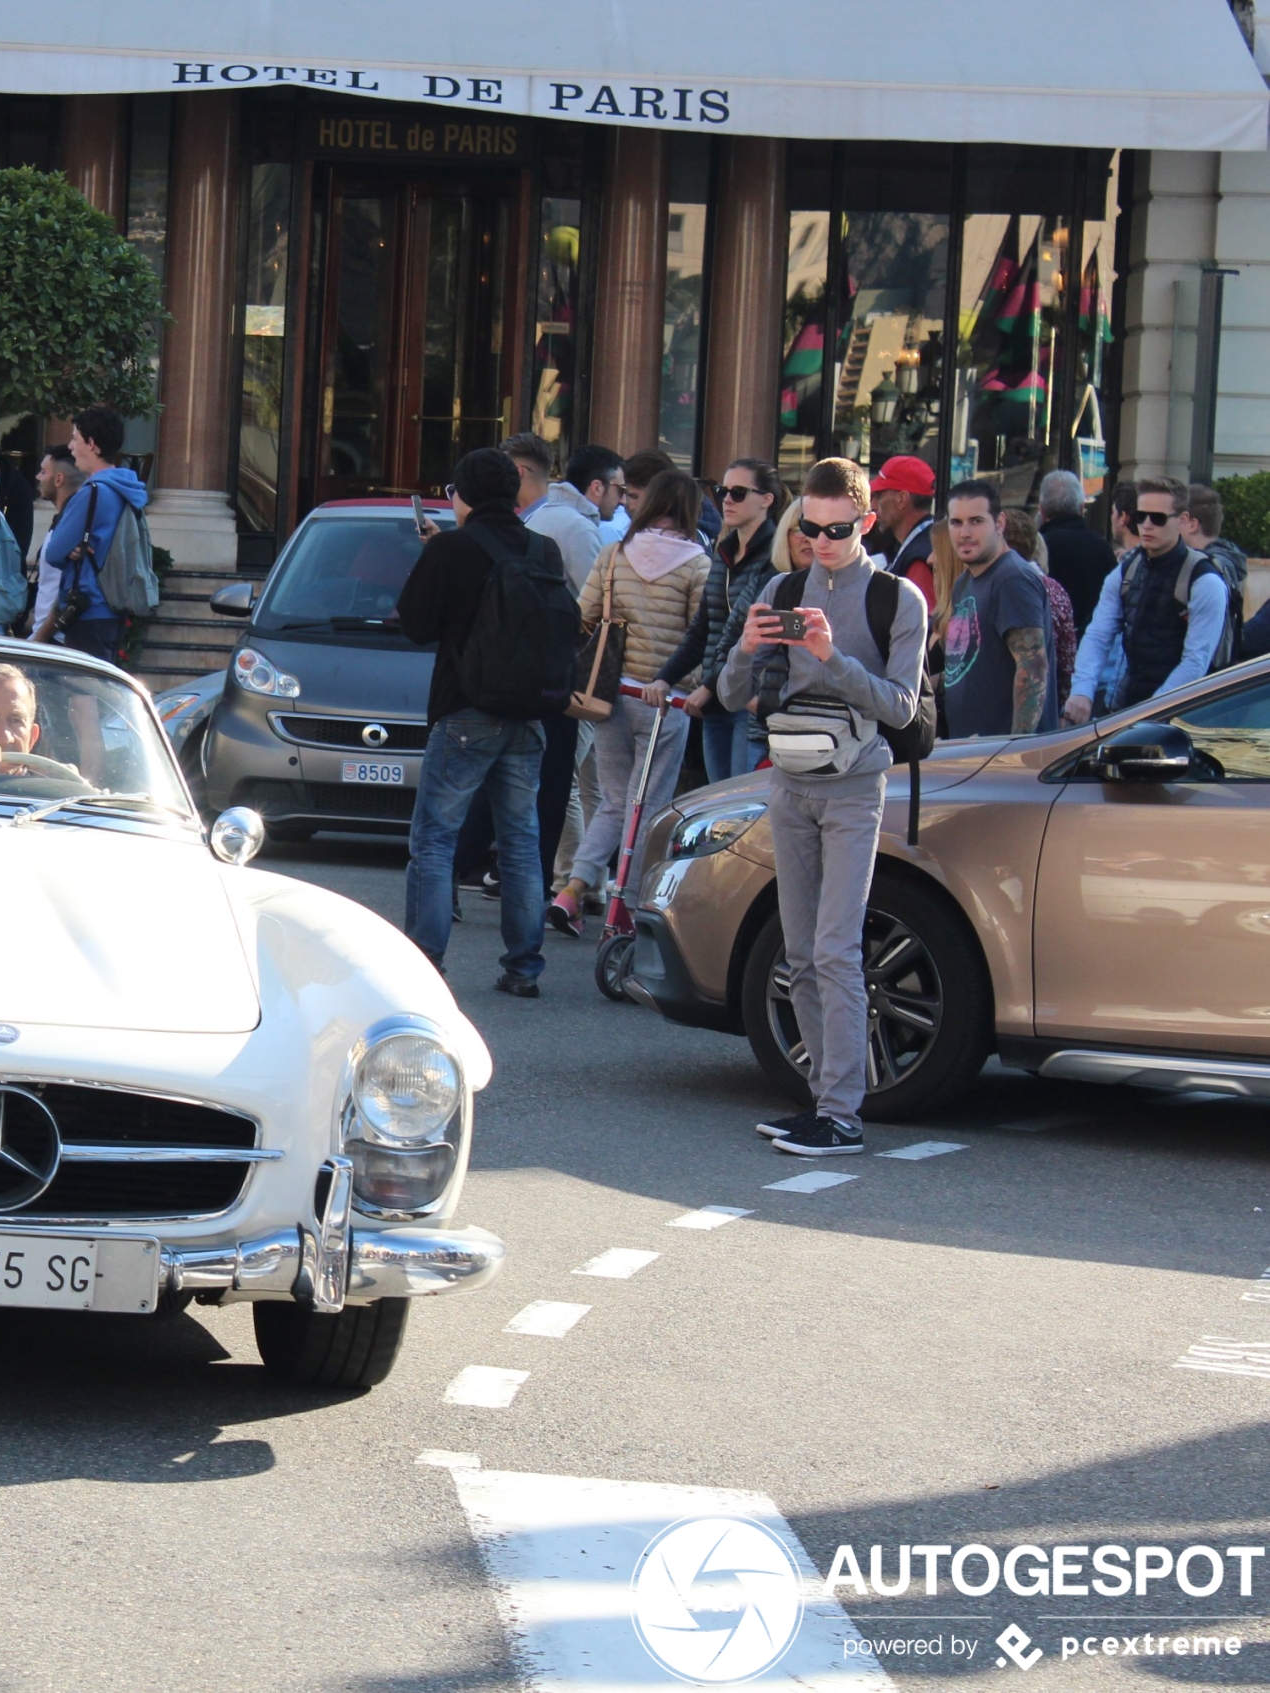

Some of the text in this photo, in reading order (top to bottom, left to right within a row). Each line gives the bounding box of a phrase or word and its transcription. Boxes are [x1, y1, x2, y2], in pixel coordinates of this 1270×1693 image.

[172, 62, 730, 124] HOTEL DE PARIS
[319, 118, 518, 156] HOTEL de PARIS
[358, 764, 402, 782] 8509
[46, 1254, 91, 1293] SG
